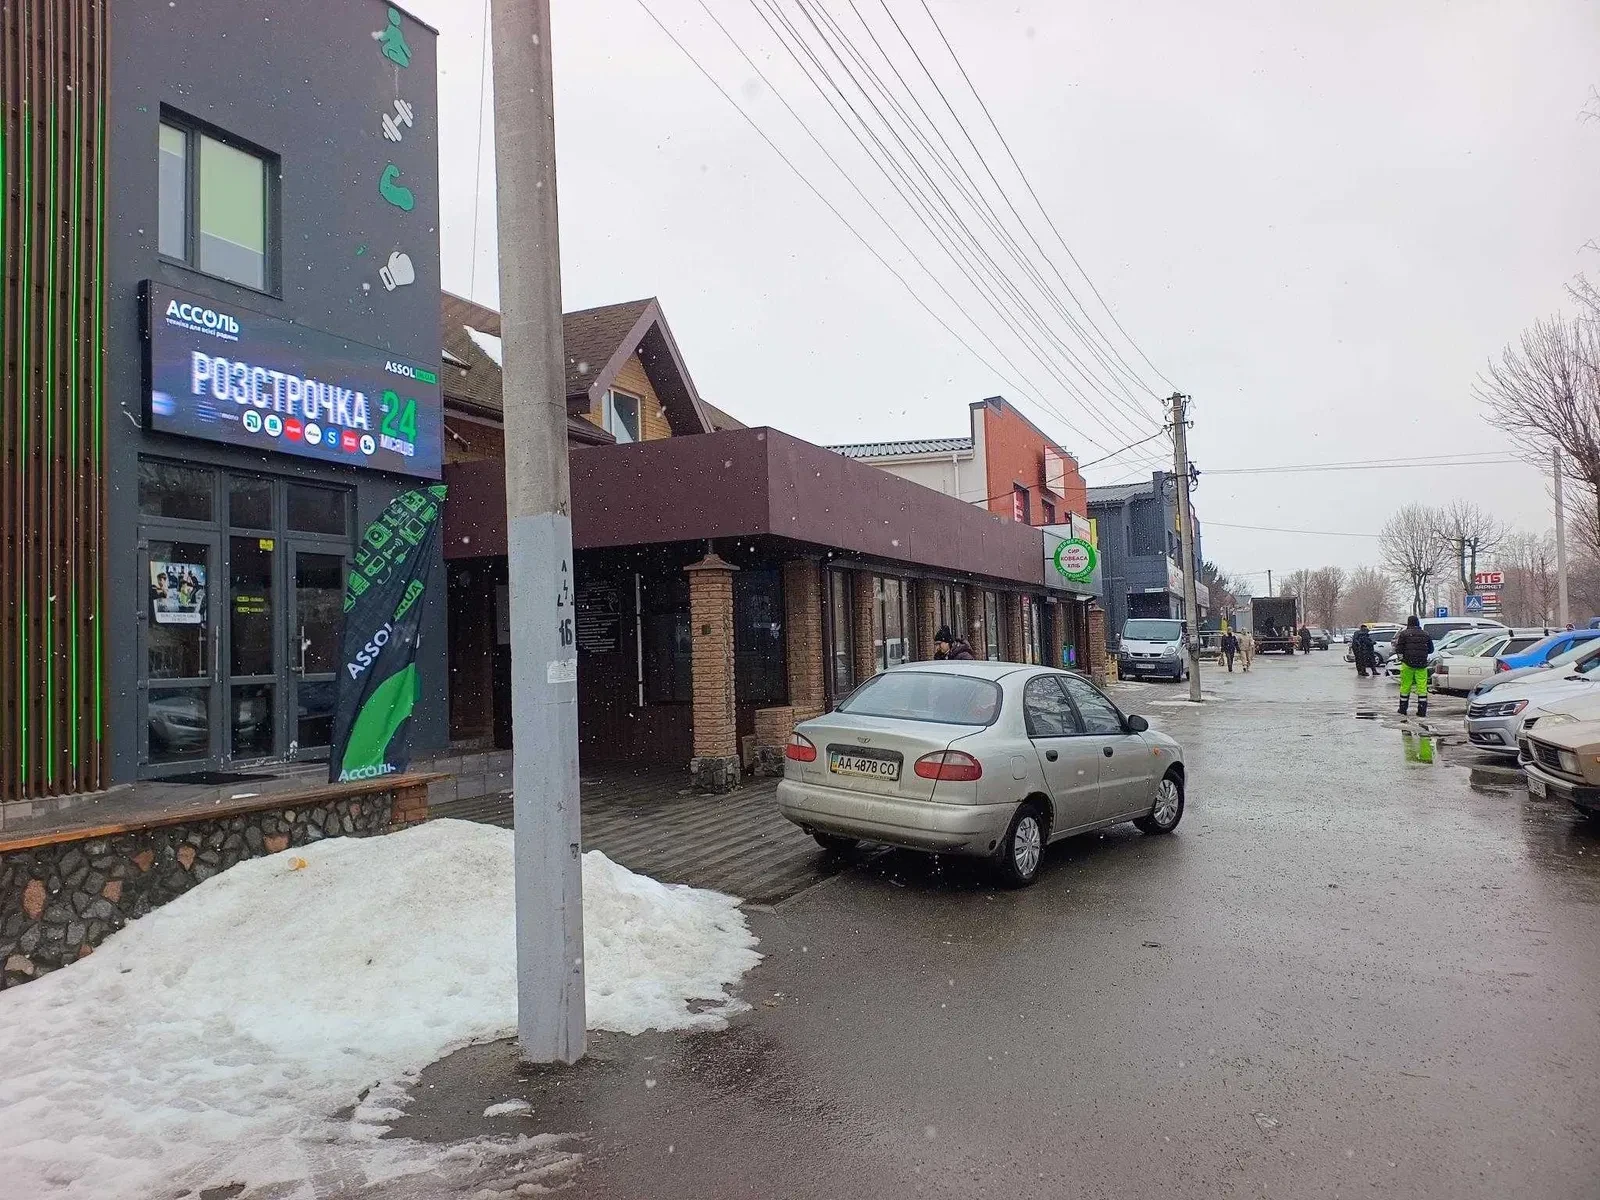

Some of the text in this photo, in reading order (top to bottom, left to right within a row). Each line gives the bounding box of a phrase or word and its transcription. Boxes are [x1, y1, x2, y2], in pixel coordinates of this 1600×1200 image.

[166, 300, 239, 333] АССОЛЬ
[385, 361, 416, 378] ASSOL
[191, 350, 369, 431] РОЗСТРОЧКА
[381, 390, 417, 445] 24
[1475, 573, 1501, 583] АТБ
[559, 618, 573, 647] 16
[838, 756, 852, 770] AA
[854, 759, 878, 773] 4878
[880, 762, 895, 775] CO
